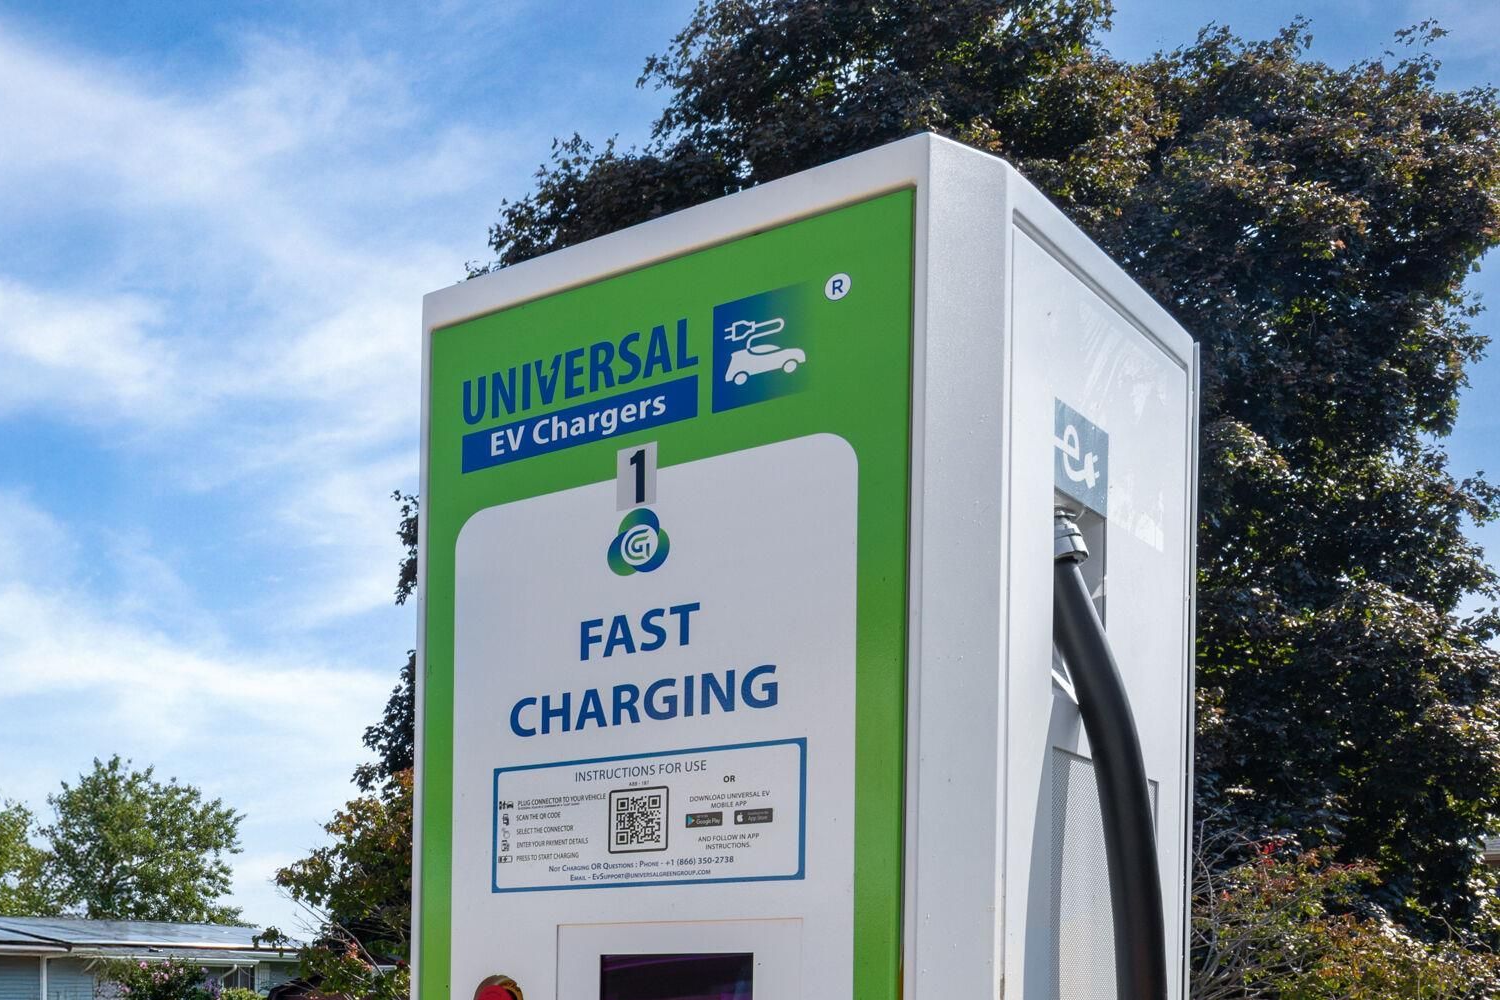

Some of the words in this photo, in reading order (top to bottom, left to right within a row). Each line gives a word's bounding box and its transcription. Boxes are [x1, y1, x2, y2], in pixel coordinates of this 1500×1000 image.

[462, 318, 699, 425] UNIVERSAL
[490, 425, 525, 457] EV
[532, 394, 667, 446] Chargers
[629, 449, 646, 504] 1
[580, 602, 700, 661] FAST
[509, 664, 778, 738] CHARGING
[575, 765, 656, 782] INSTRUCTIONS
[658, 762, 682, 775] FOR
[685, 760, 707, 772] USE
[723, 775, 736, 783] OR
[517, 799, 531, 807] PLUG
[532, 797, 562, 806] CONNECTOR
[563, 796, 570, 804] TO
[570, 795, 584, 803] YOUR
[585, 793, 606, 801] VEHICLE
[689, 793, 726, 802] DOWNLOAD
[726, 791, 760, 800] UNIVERSAL
[710, 801, 734, 809] MOBILE
[516, 814, 529, 822] SCAN
[530, 813, 539, 821] THE
[516, 827, 533, 835] SELECT
[543, 825, 574, 834] CONNECTOR
[546, 839, 568, 847] PAYMENT
[712, 834, 738, 842] FOLLOW
[538, 853, 554, 861] START
[554, 852, 579, 860] CHARGING
[591, 862, 602, 870] OR
[676, 857, 696, 866] (866)
[698, 856, 734, 864] 350-2738
